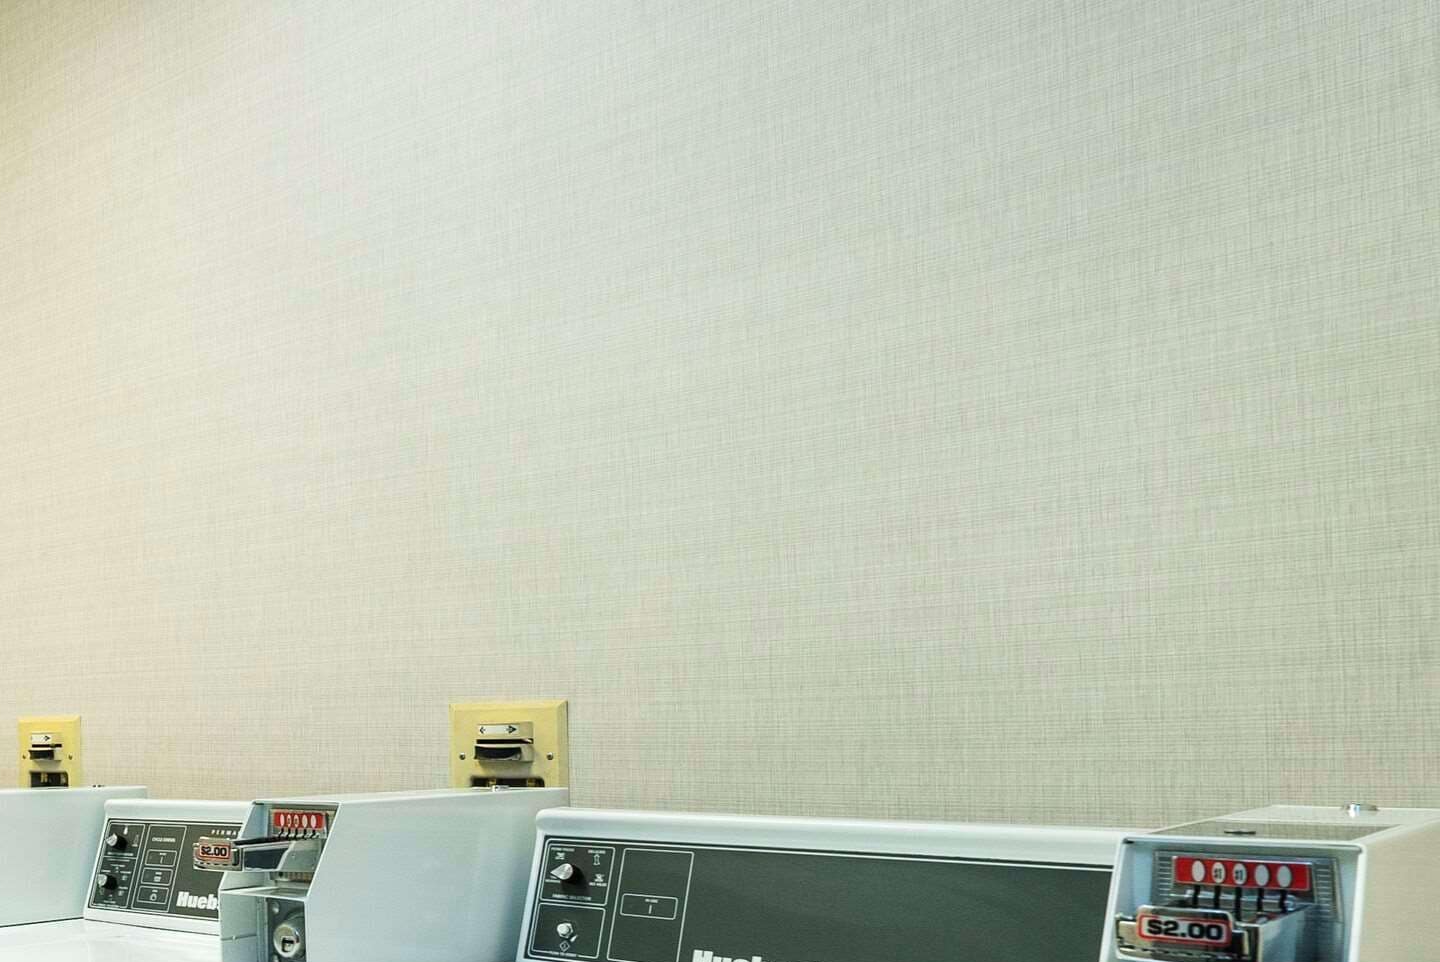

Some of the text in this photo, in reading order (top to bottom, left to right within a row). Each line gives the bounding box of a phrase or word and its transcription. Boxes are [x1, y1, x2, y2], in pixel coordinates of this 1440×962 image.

[200, 845, 228, 857] $2.00
[176, 891, 219, 911] Hueb
[1147, 919, 1223, 940] $2.00
